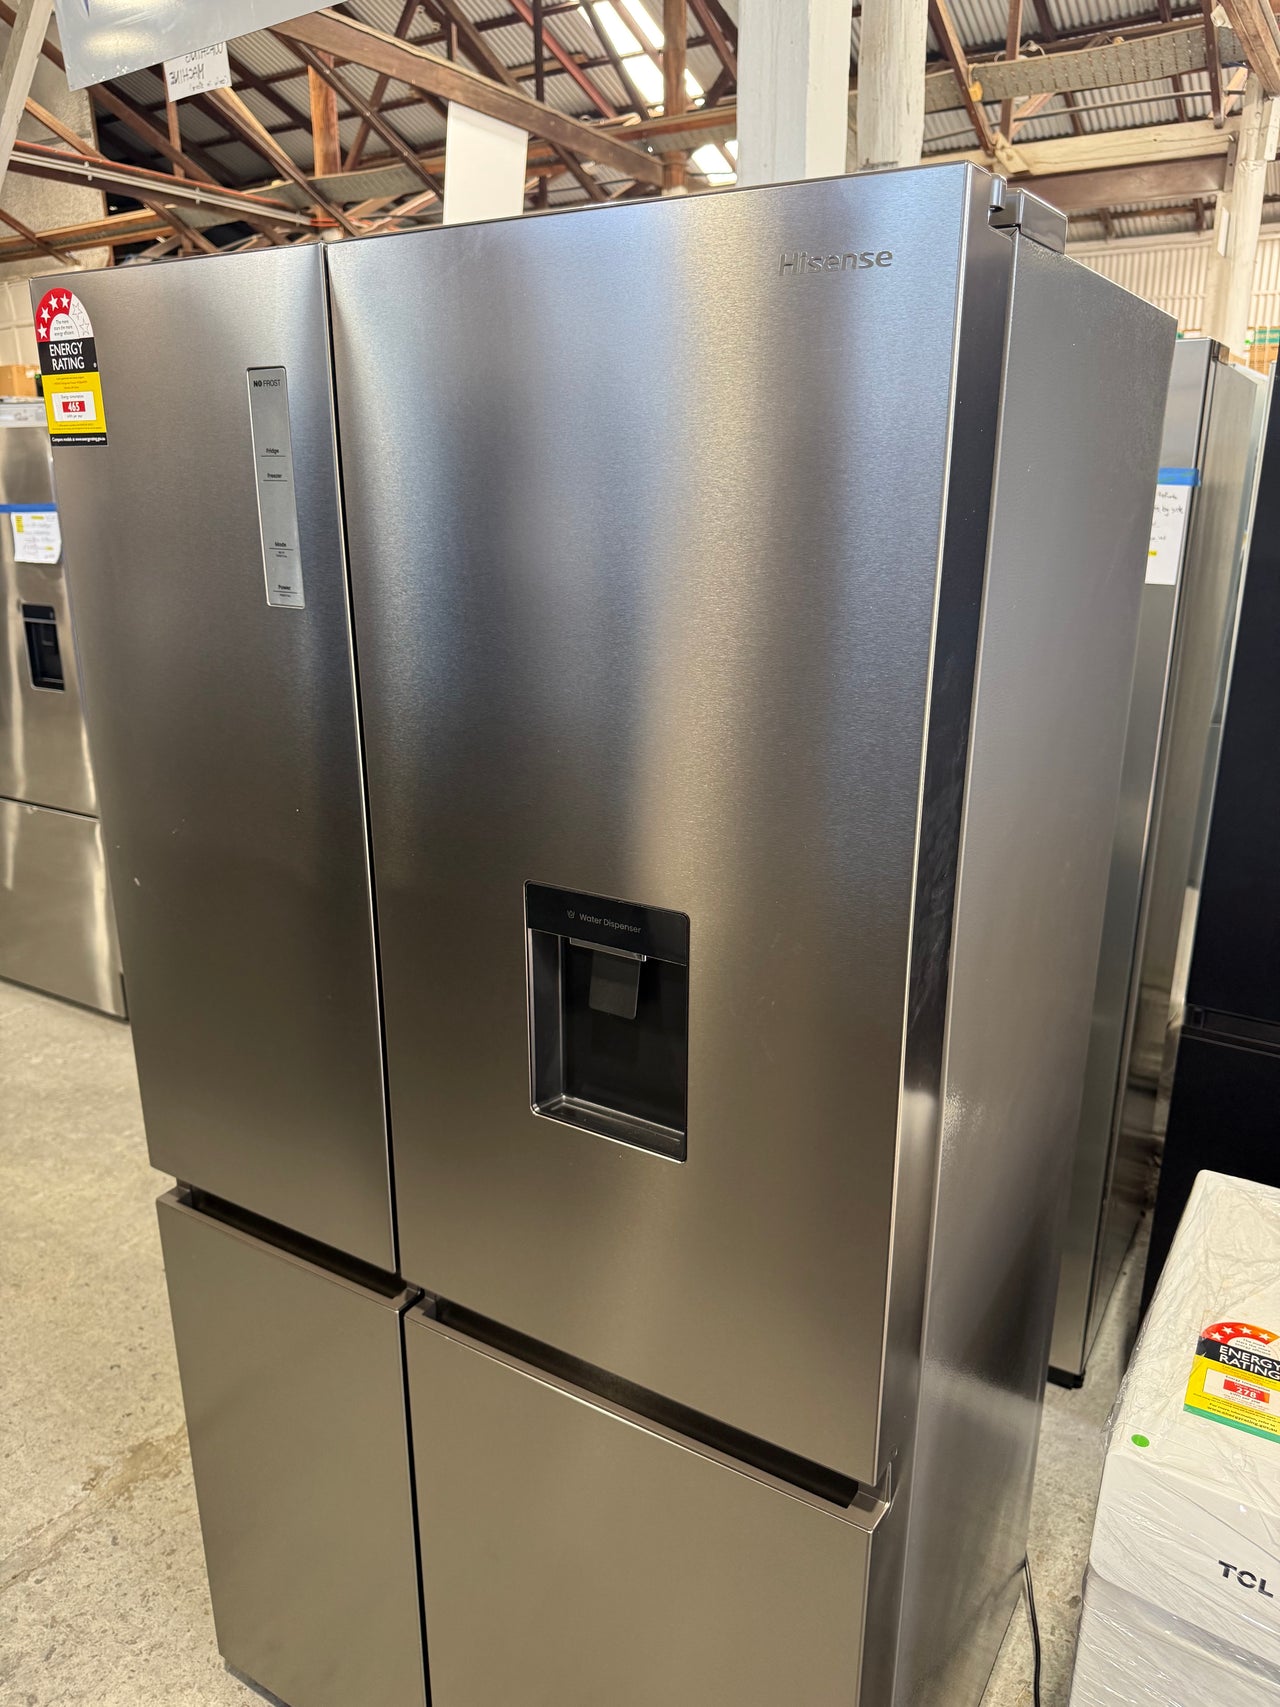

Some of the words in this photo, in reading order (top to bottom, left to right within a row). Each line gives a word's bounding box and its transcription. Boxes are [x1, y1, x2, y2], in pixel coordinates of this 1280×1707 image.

[779, 250, 893, 276] Hisense
[49, 341, 83, 357] ENERGY
[51, 356, 85, 371] RATING
[253, 380, 263, 388] NO
[263, 379, 281, 387] FROST
[67, 401, 81, 412] 465
[579, 913, 602, 925] Water
[603, 918, 642, 934] Dispenser
[1219, 1345, 1280, 1371] ENERGY
[1219, 1354, 1280, 1380] RATING
[1236, 1388, 1257, 1399] 278
[1218, 1559, 1274, 1599] TCL
